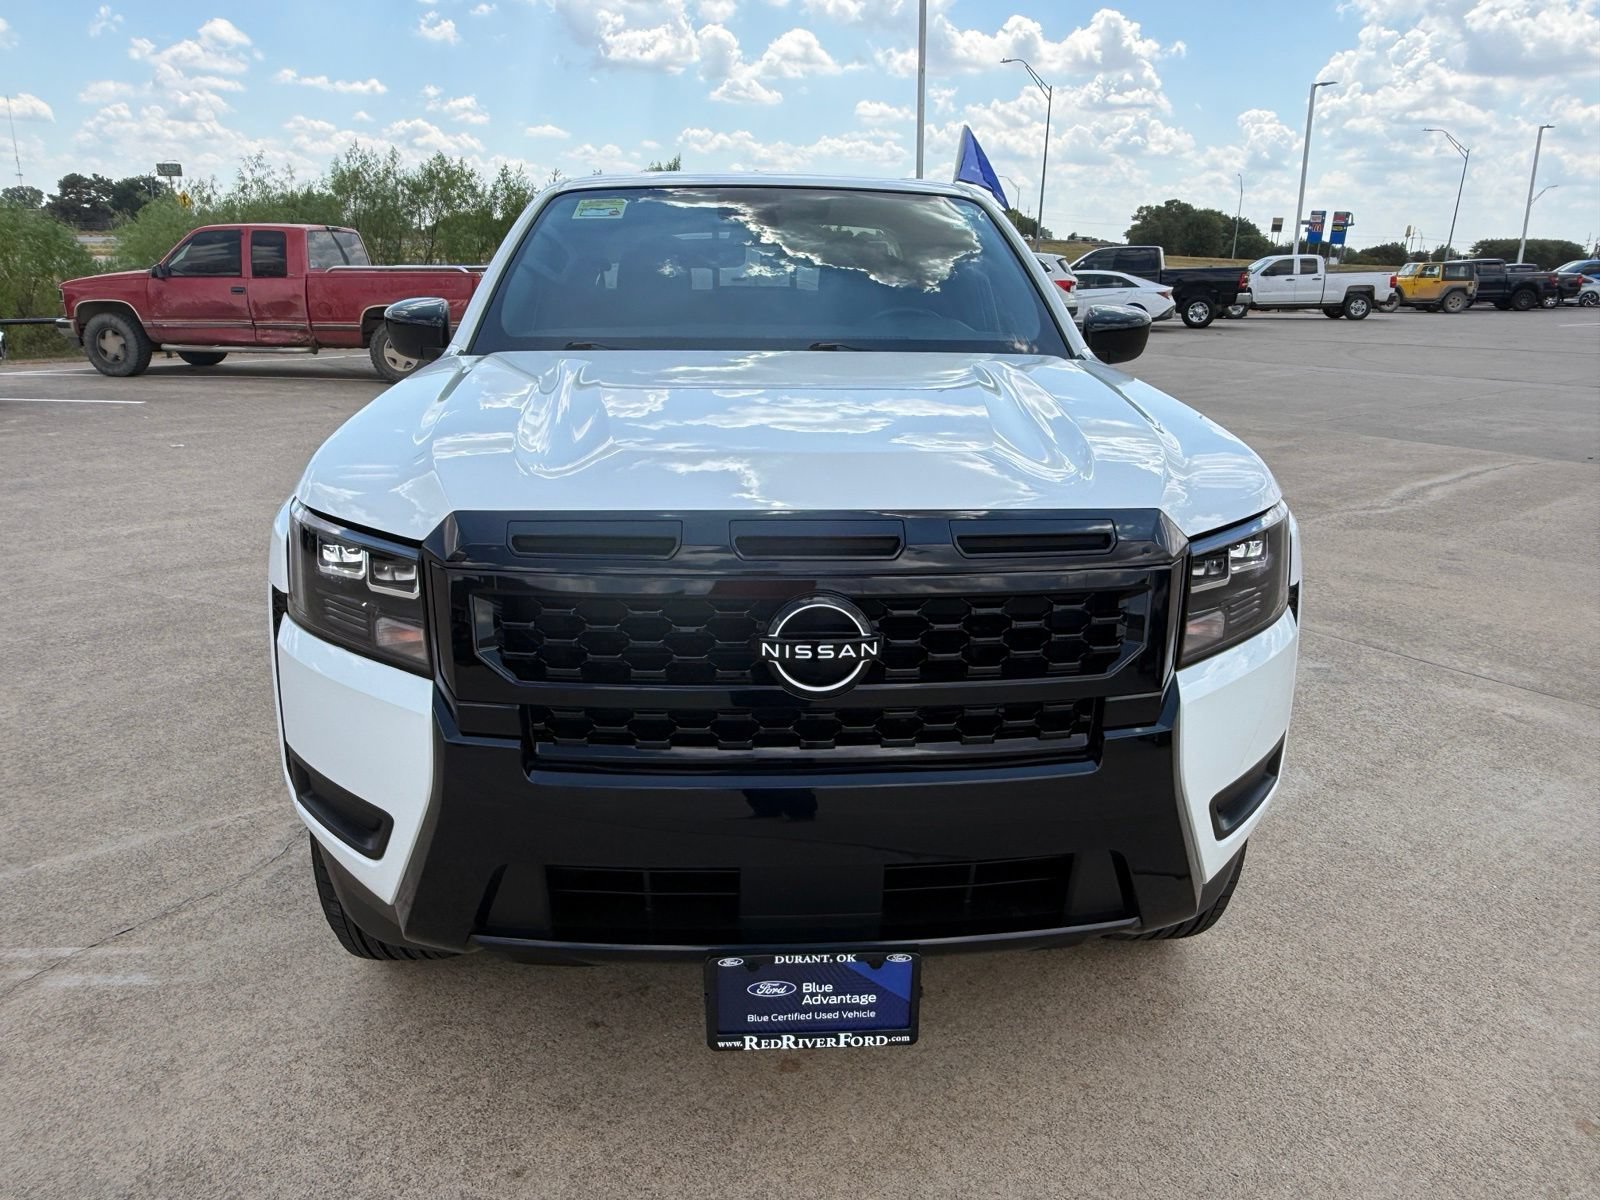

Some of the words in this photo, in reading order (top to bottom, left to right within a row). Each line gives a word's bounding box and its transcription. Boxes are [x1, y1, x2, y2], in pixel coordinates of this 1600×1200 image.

[761, 641, 878, 659] NISSAN
[774, 955, 833, 965] DURANT,
[836, 953, 857, 963] OK
[756, 982, 787, 995] Ford
[802, 982, 833, 993] Blue
[802, 993, 877, 1005] Advantage
[747, 1013, 769, 1022] Blue
[771, 1011, 812, 1022] Certified
[814, 1010, 839, 1020] Used
[841, 1009, 876, 1019] Vehicle
